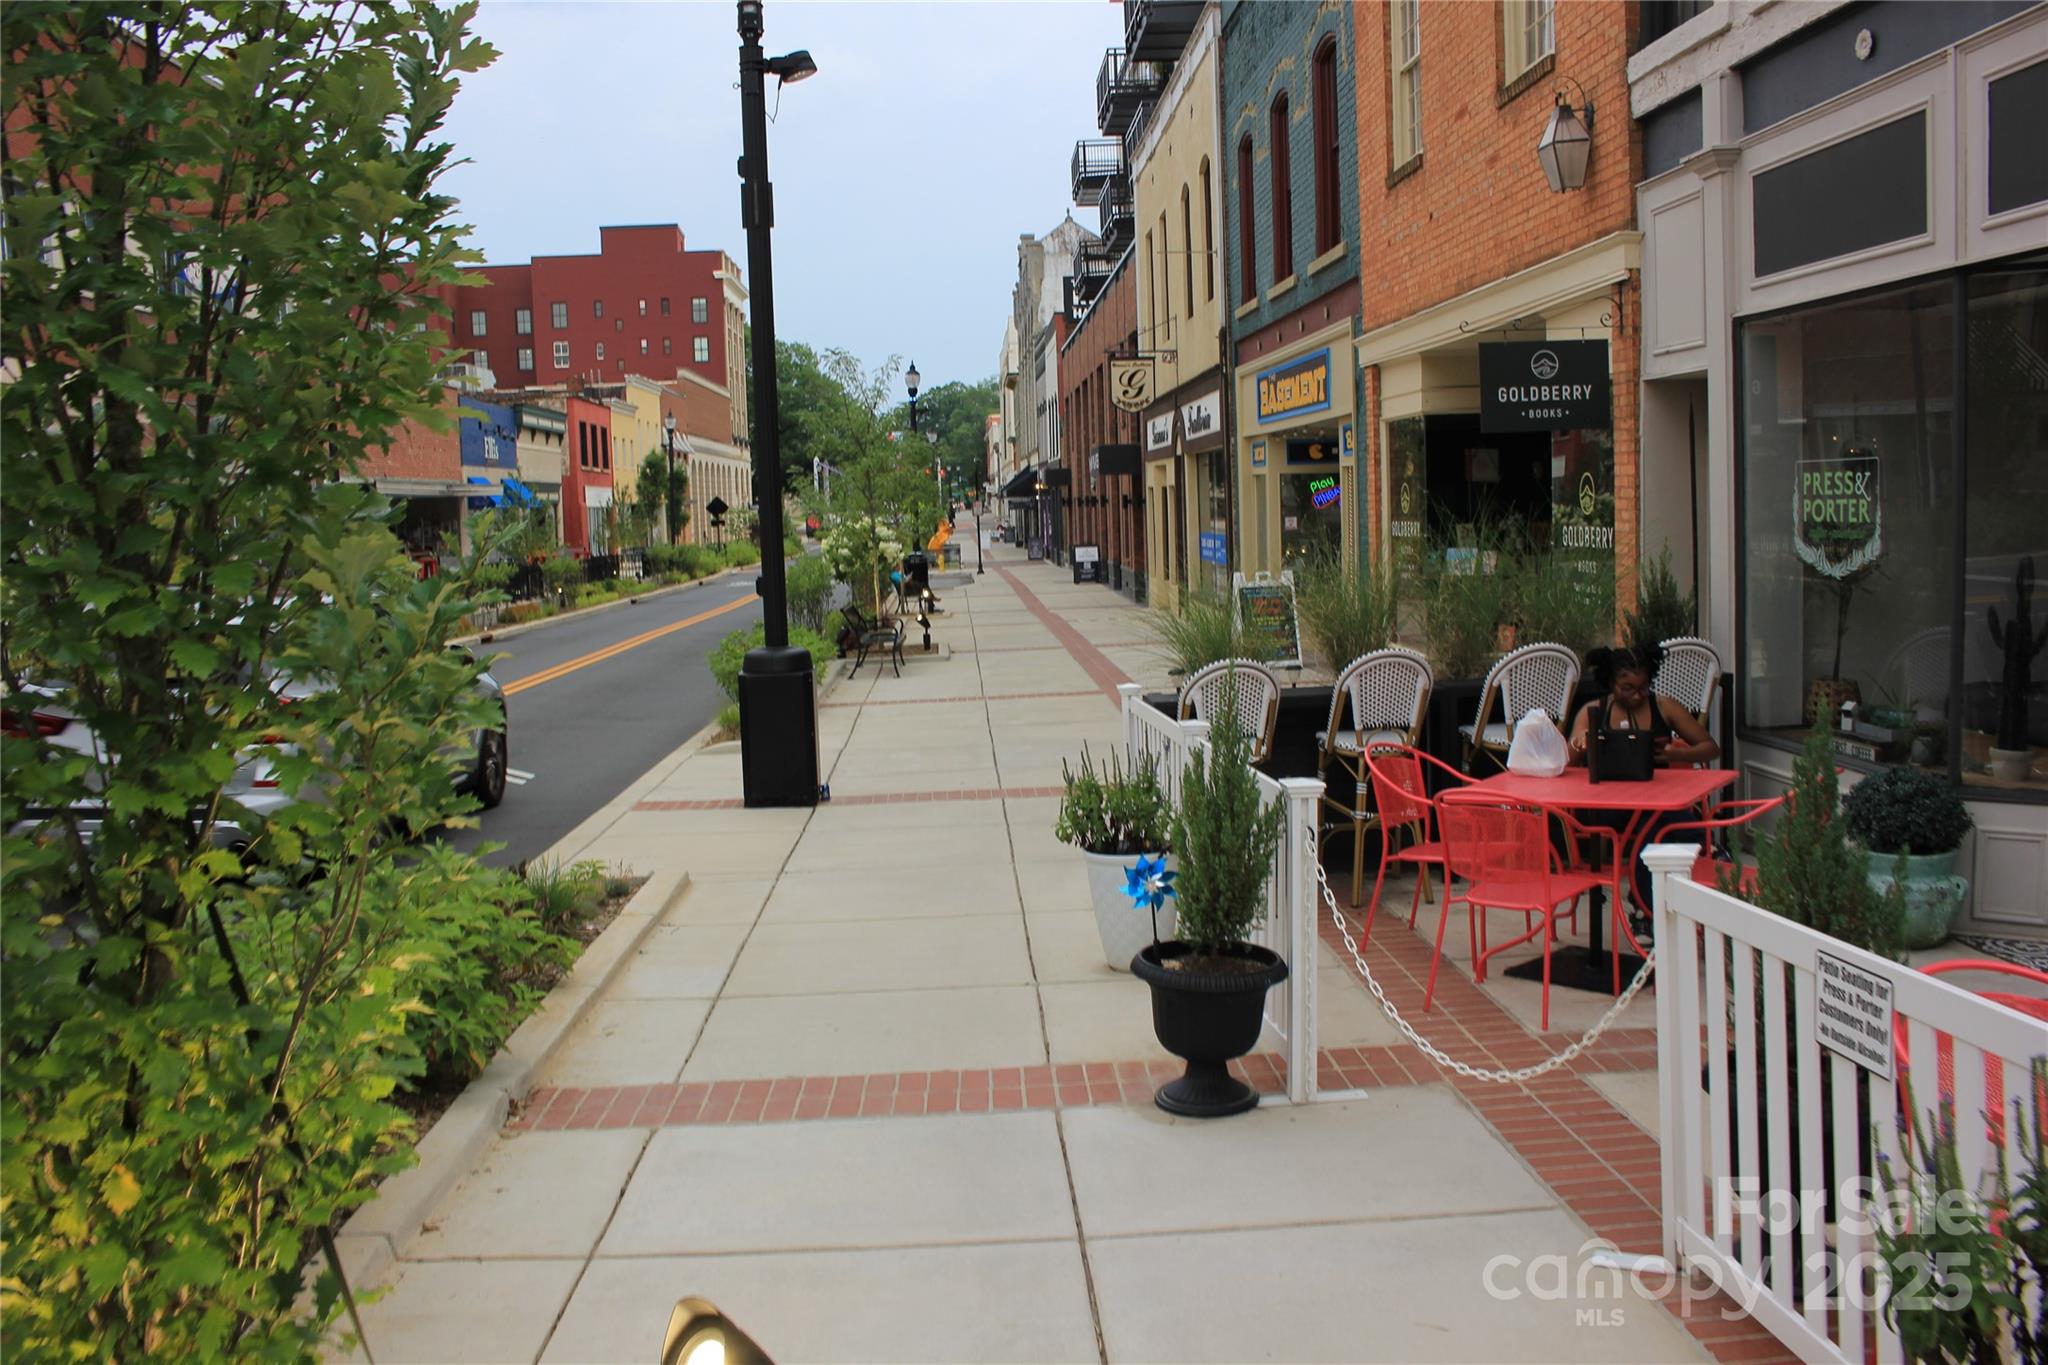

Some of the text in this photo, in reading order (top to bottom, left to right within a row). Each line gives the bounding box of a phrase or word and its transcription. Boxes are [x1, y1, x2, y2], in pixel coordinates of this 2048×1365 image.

[1118, 367, 1147, 400] G
[1260, 366, 1326, 417] BASEMENT
[1498, 385, 1592, 402] GOLDBERRY
[1528, 408, 1562, 418] BOOKS
[1310, 477, 1335, 494] Play
[1313, 486, 1342, 508] PINBA
[1803, 499, 1870, 523] PORTER
[1391, 521, 1421, 537] GOLDBERRY
[1562, 525, 1614, 549] GOLDBERRY
